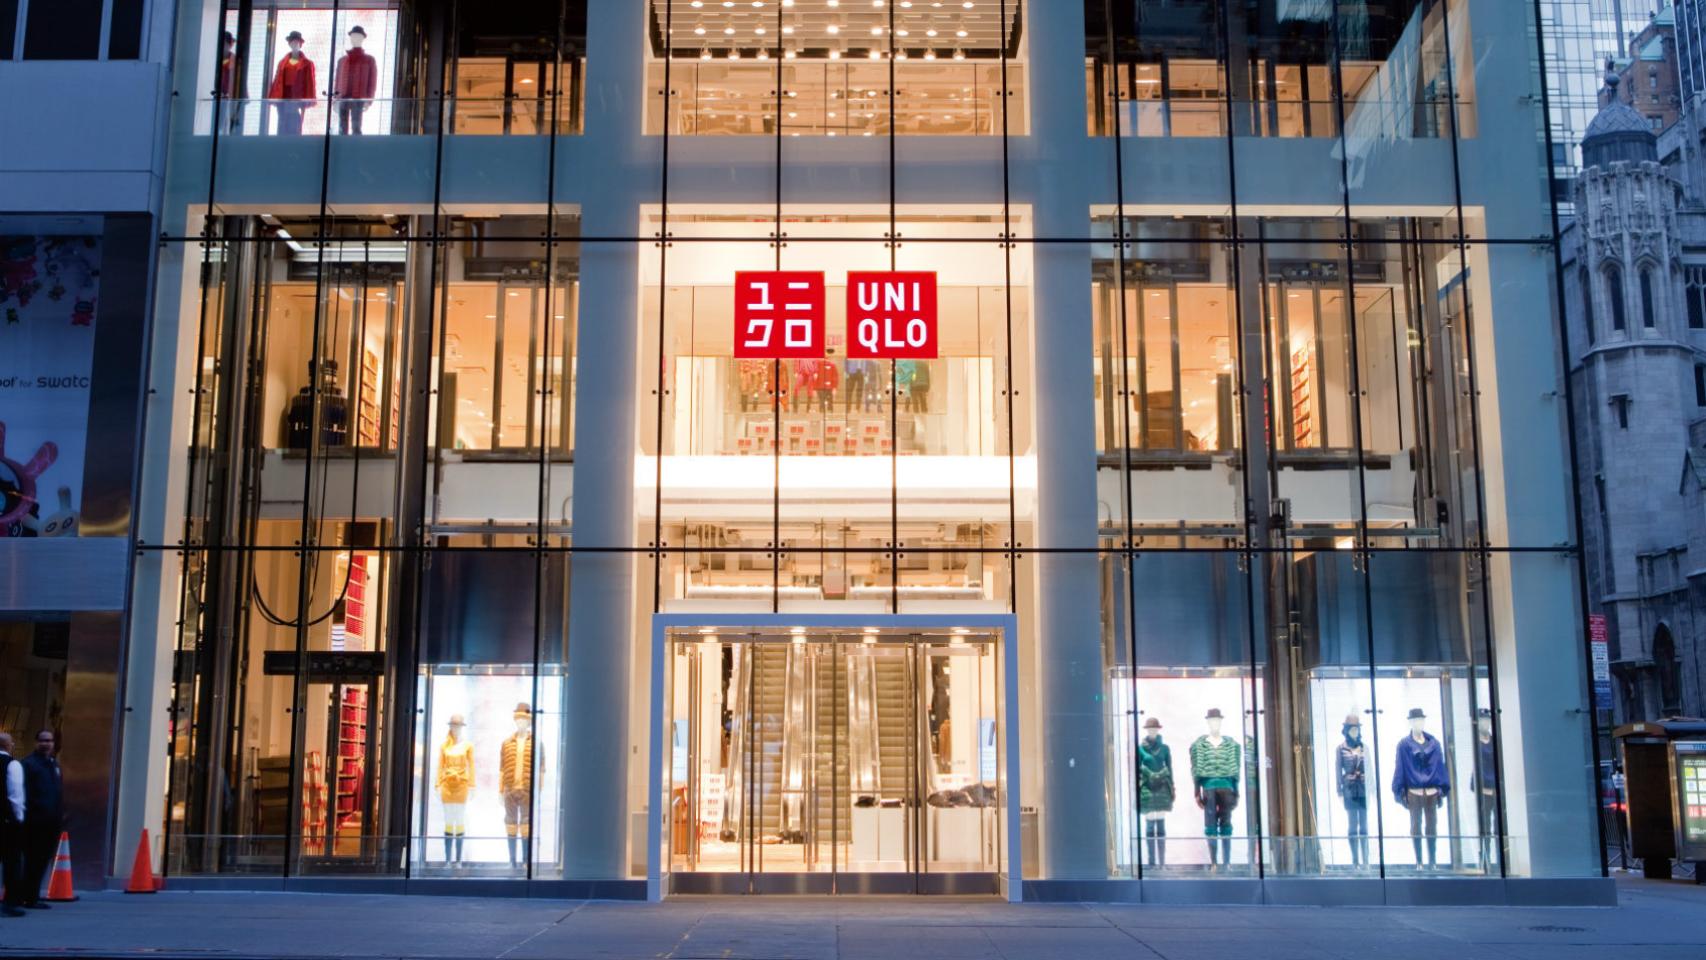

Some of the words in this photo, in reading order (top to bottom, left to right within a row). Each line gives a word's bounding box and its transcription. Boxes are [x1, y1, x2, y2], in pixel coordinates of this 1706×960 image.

[746, 282, 813, 311] ユニ
[857, 282, 921, 312] UNI
[744, 319, 813, 348] クロ
[858, 318, 928, 353] QLO
